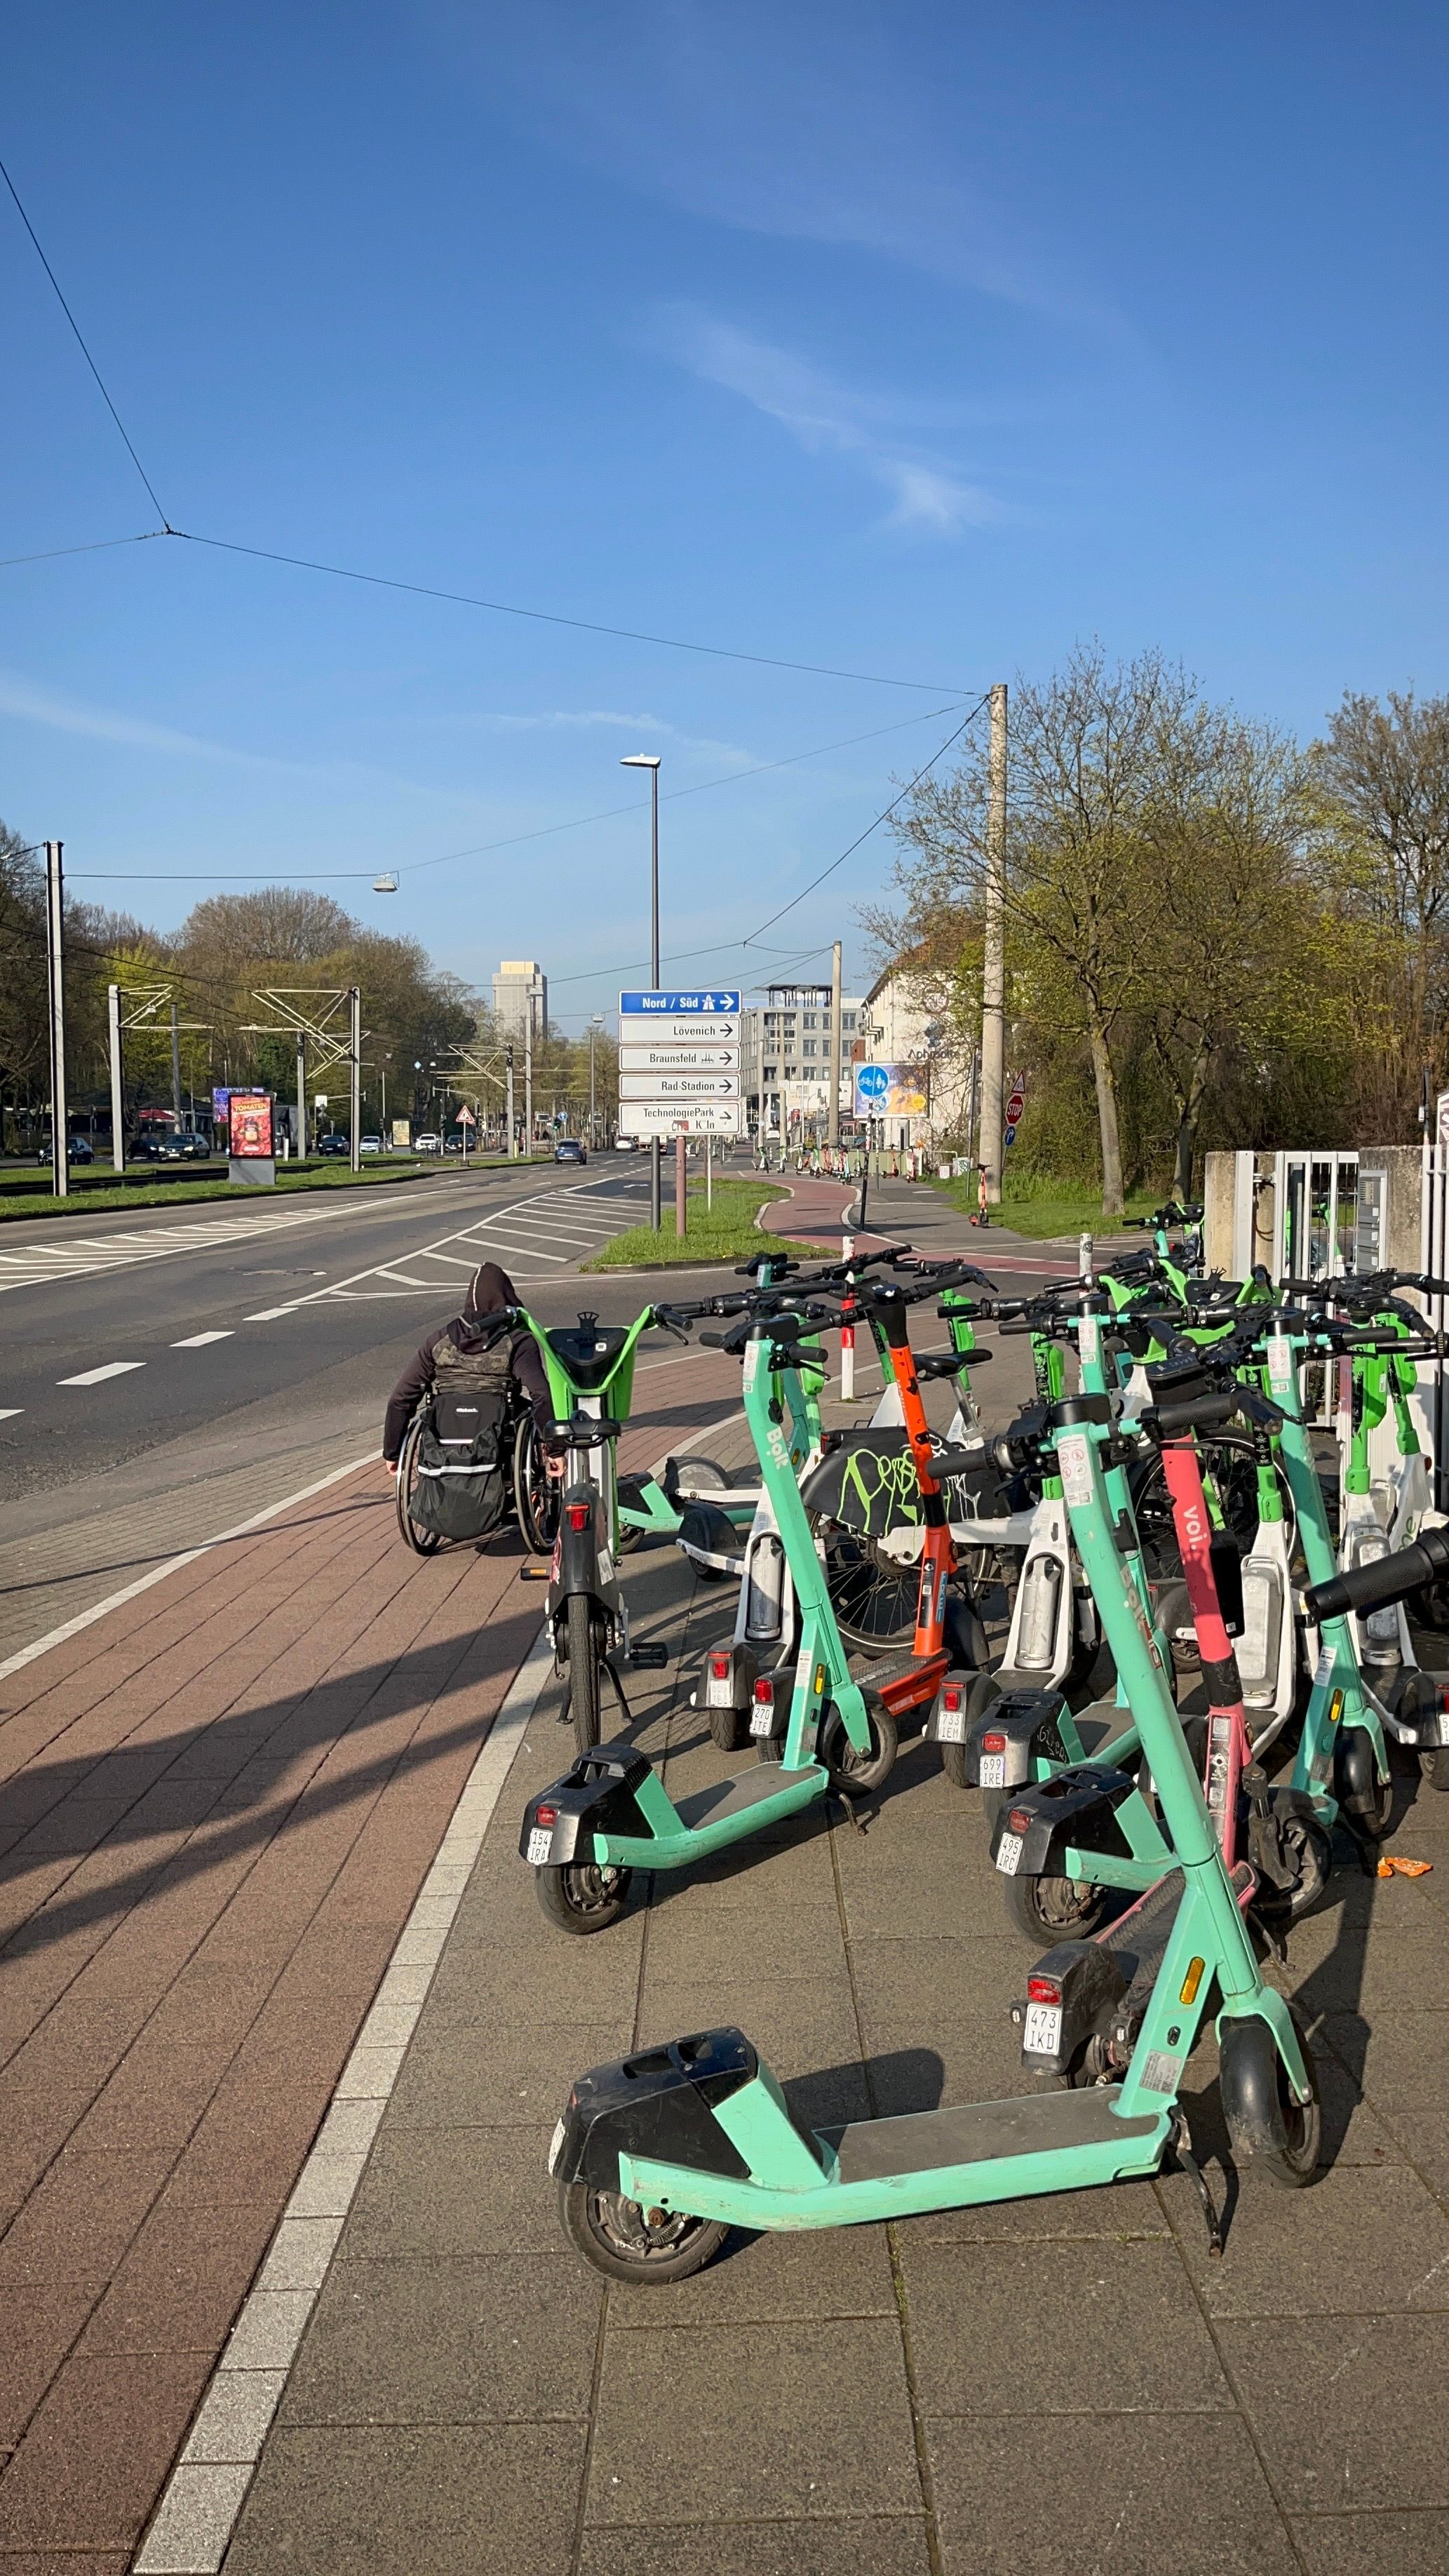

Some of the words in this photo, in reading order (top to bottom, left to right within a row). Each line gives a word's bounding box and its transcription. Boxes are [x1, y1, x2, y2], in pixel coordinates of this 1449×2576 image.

[642, 997, 666, 1008] Nord
[670, 997, 675, 1009] /
[680, 997, 699, 1008] Süd
[673, 1025, 716, 1035] Lövenich
[649, 1053, 696, 1063] Braunsfeld
[661, 1081, 715, 1091] Rad-Stadion
[643, 1107, 714, 1119] TechnologiePark
[1007, 1103, 1022, 1116] STOP
[696, 1120, 715, 1129] Kln
[766, 1426, 789, 1470] Bolt
[755, 1708, 770, 1720] 270
[943, 1714, 960, 1725] 733
[983, 1758, 1001, 1770] 699
[983, 1773, 1001, 1785] IRE
[532, 1832, 548, 1845] 154
[1002, 1839, 1018, 1855] 495
[530, 1847, 546, 1862] IRA
[999, 1853, 1015, 1871] IRC
[1031, 2009, 1056, 2029] 473
[1030, 2030, 1054, 2050] IKD
